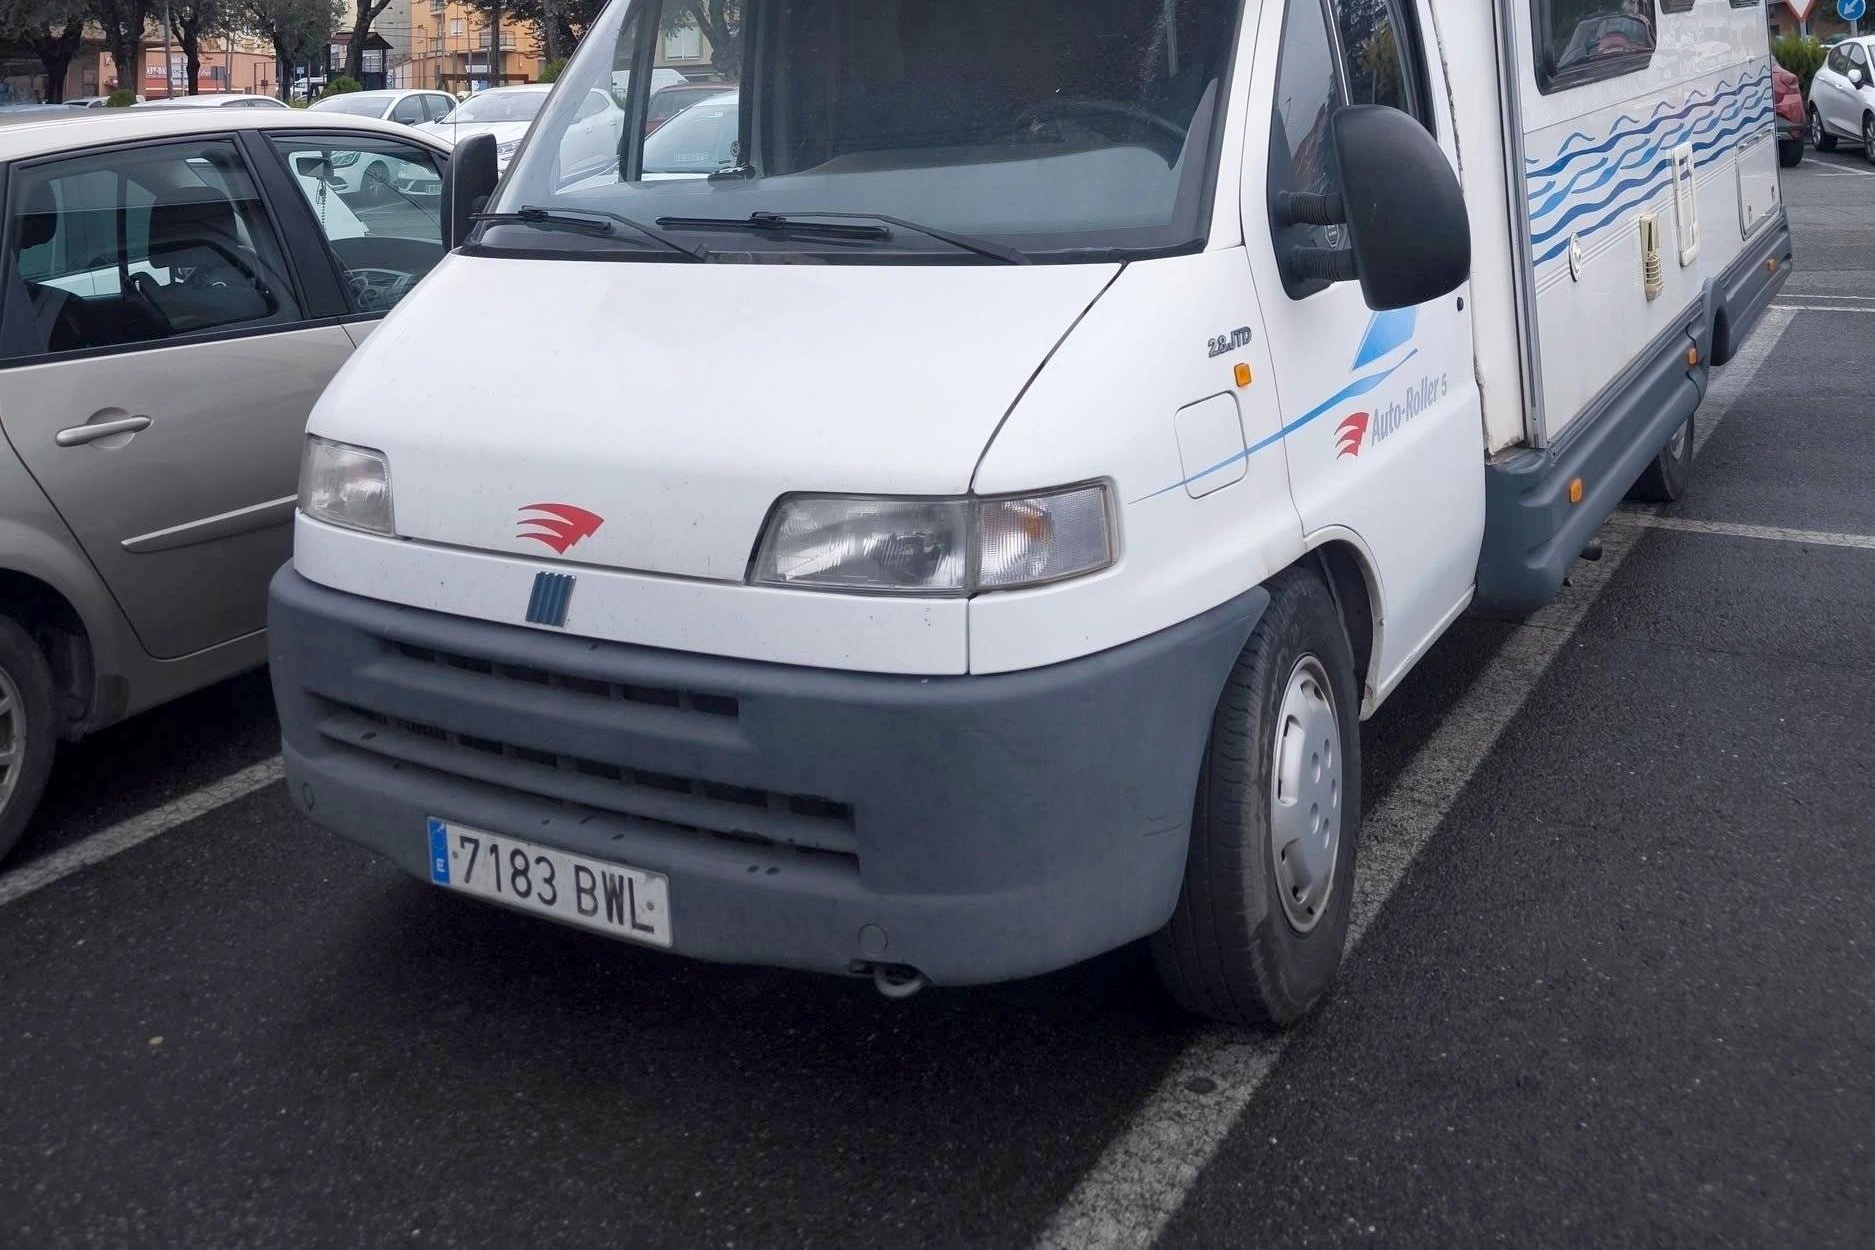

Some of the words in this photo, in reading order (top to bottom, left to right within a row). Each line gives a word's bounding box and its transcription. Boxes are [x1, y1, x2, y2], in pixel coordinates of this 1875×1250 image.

[1372, 375, 1439, 447] Auto-Roller
[1441, 372, 1447, 396] 5
[436, 858, 446, 872] E
[460, 835, 557, 906] 7183
[574, 864, 654, 934] BWL
